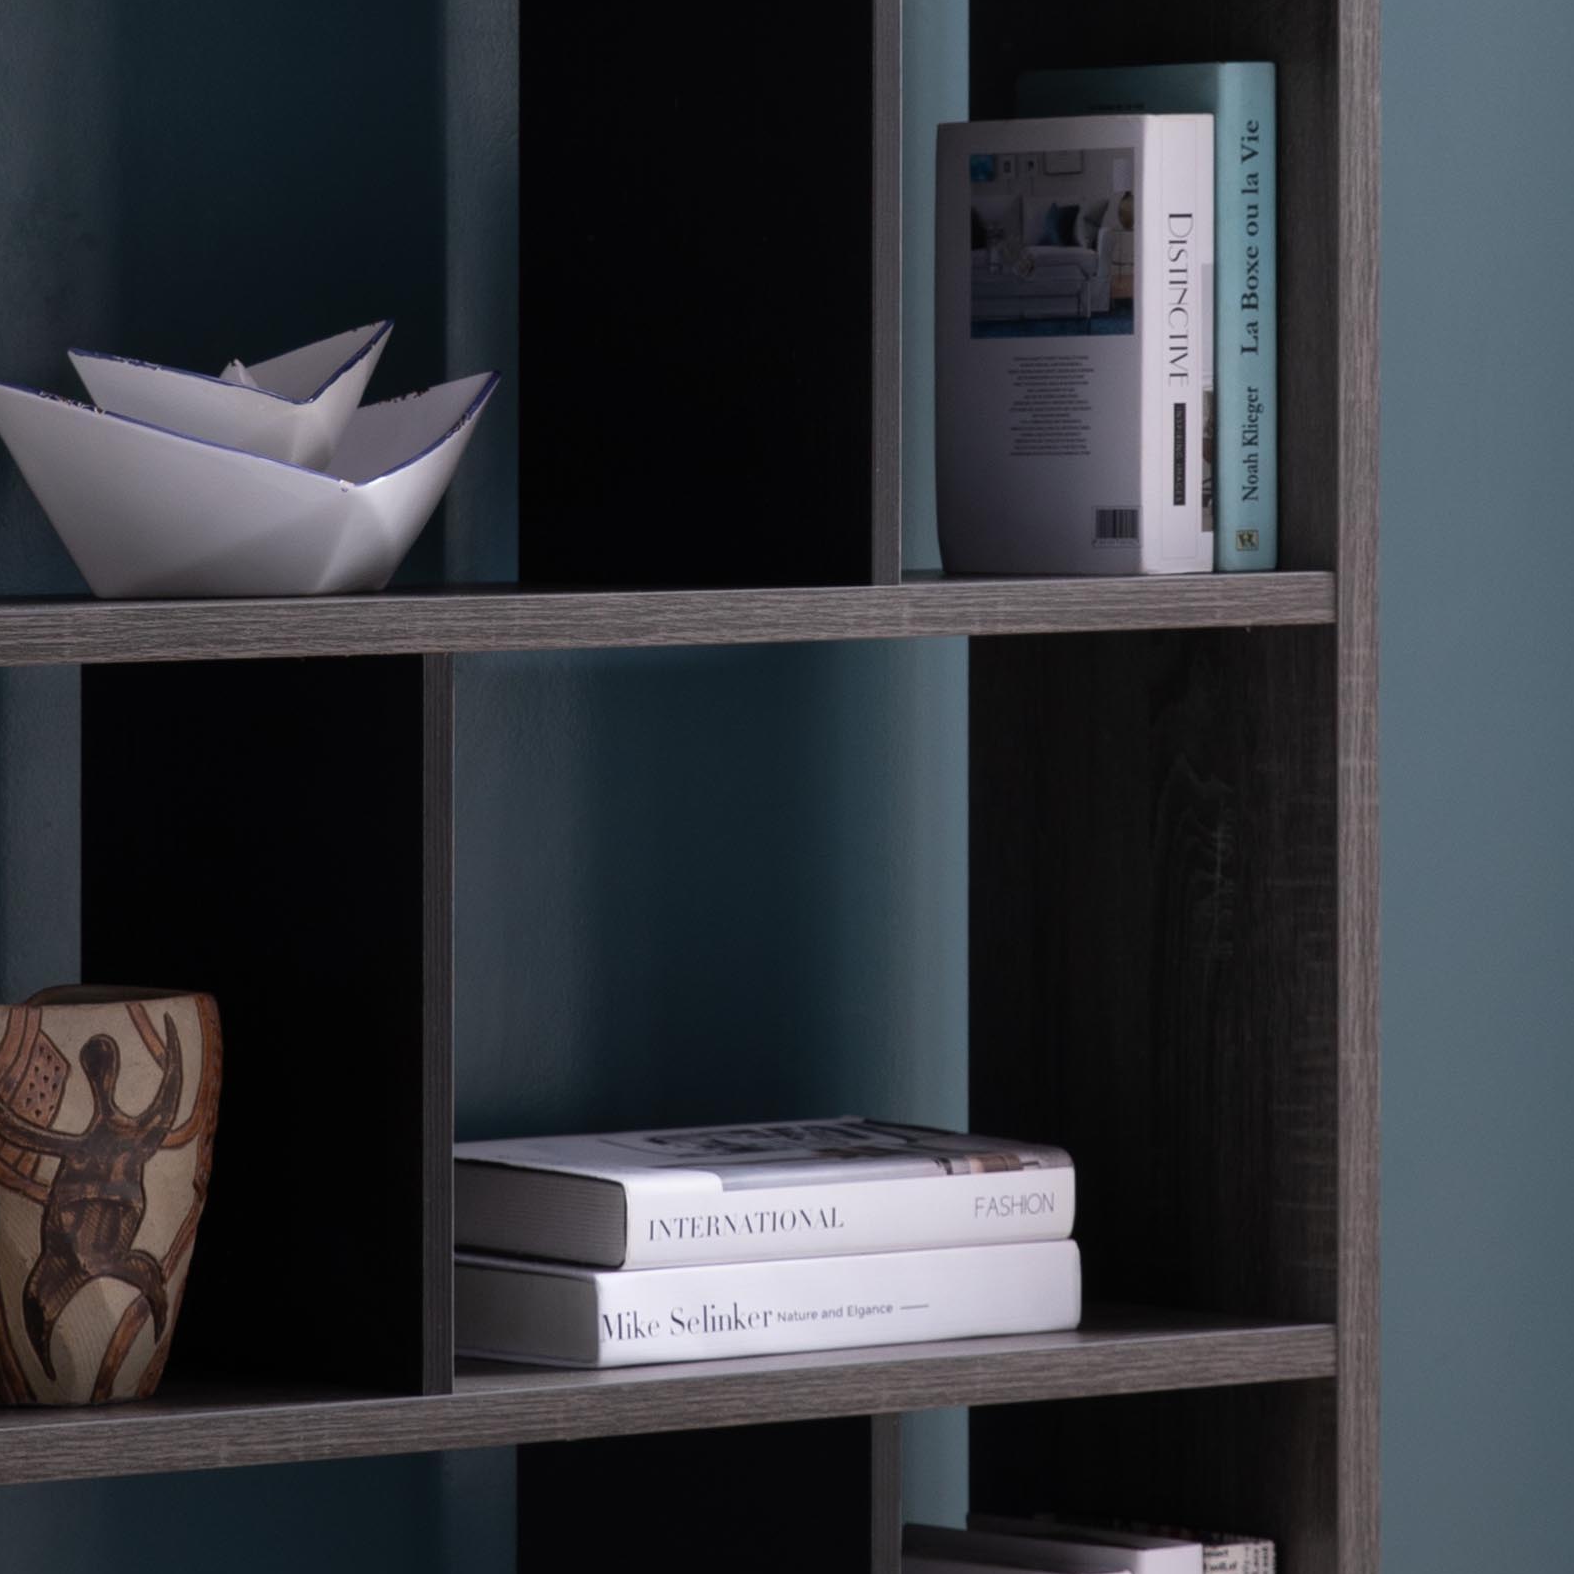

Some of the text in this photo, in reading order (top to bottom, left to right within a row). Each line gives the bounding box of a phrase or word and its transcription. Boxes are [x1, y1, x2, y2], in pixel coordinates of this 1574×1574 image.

[1240, 119, 1260, 356] La Boxe ou la Vie
[1168, 213, 1194, 387] DISTINCTIVE
[1242, 386, 1264, 502] Noah Klieger
[648, 1206, 844, 1242] INTERNATIONAL
[975, 1191, 1055, 1220] FASHION
[601, 1302, 893, 1342] Mike Selinker Nature and Elgance
